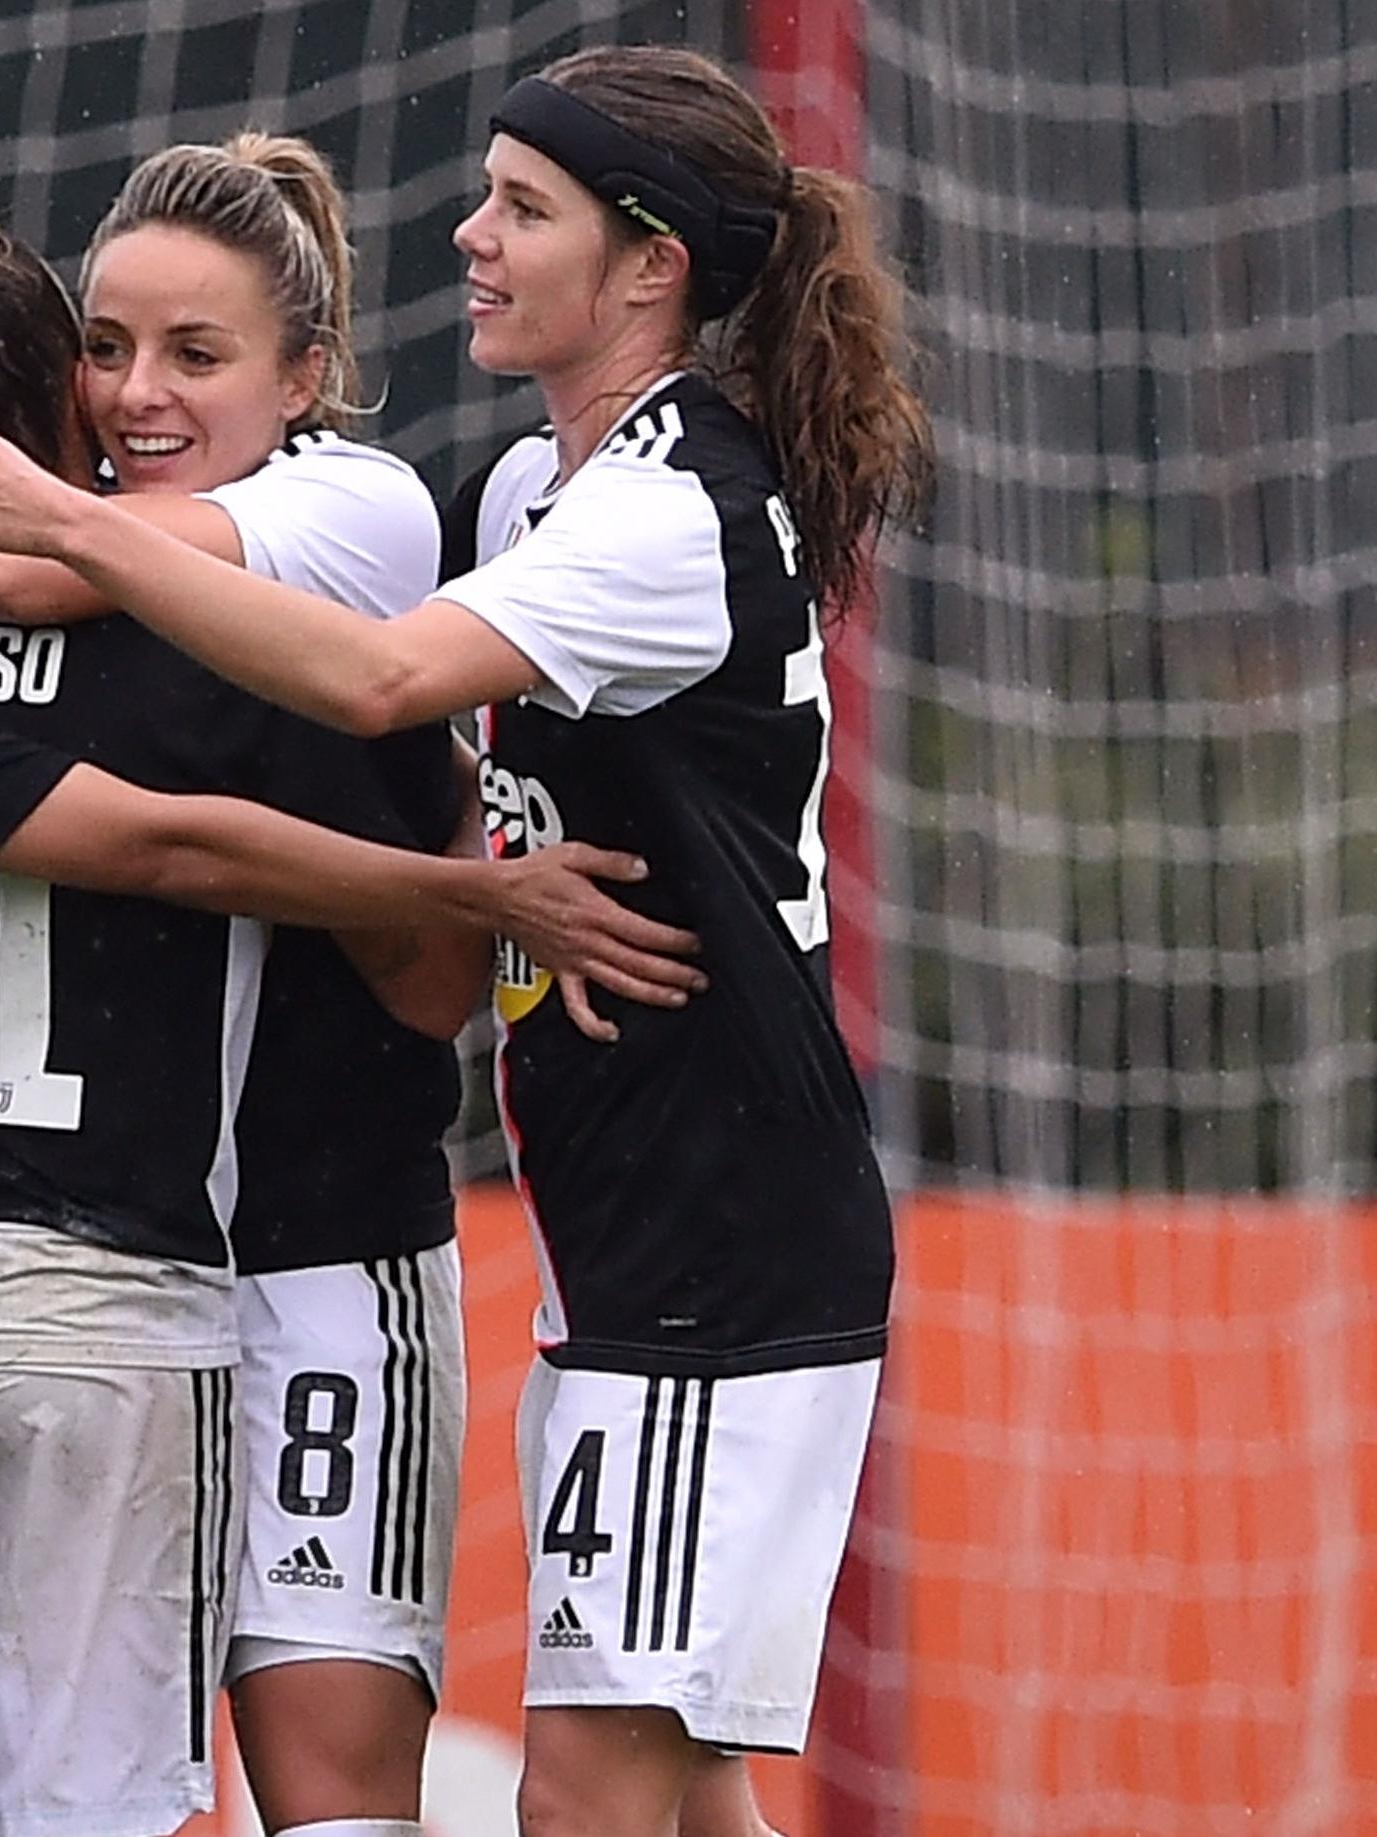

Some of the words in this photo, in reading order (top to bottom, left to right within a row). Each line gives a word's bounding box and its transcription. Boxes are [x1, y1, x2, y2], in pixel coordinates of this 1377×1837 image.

[277, 1371, 359, 1518] 8
[541, 1429, 613, 1577] 4
[267, 1561, 345, 1590] adidas
[539, 1629, 593, 1649] adidas
